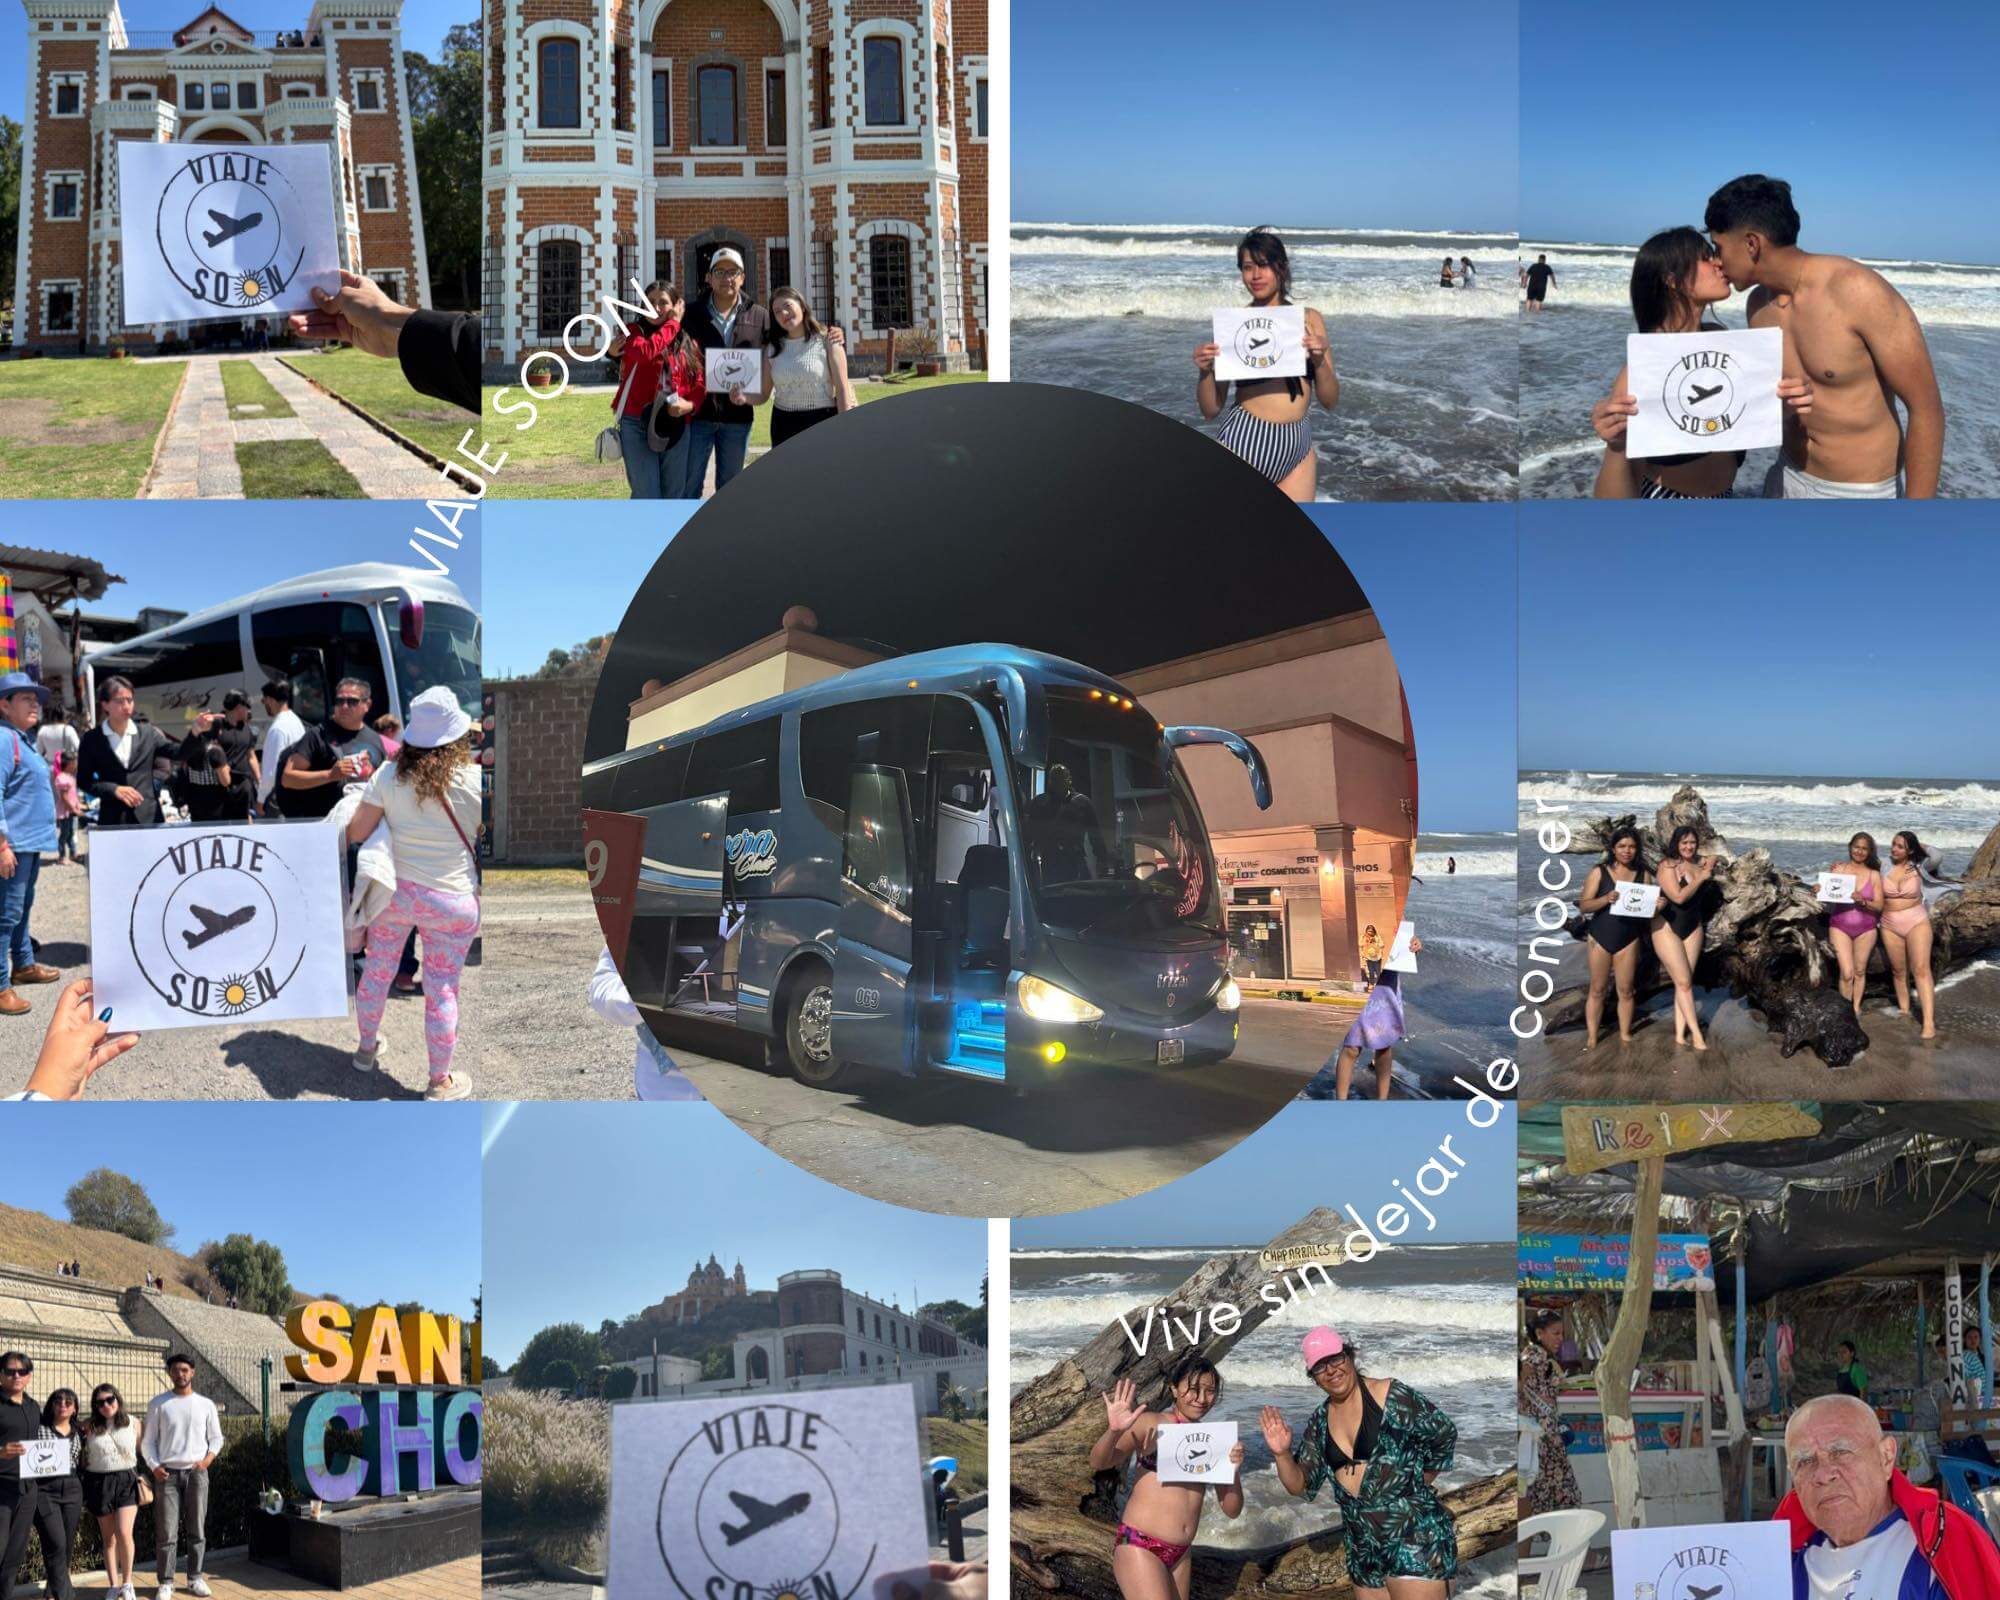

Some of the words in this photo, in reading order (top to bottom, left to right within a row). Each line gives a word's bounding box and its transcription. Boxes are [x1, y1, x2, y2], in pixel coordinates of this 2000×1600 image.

[187, 155, 270, 185] VIAJE
[1244, 319, 1273, 329] VIAJE
[1682, 351, 1730, 370] VIAJE
[168, 839, 267, 876] VIAJE
[1260, 865, 1310, 877] COSMÉTICOS
[855, 987, 881, 1009] 069
[1518, 1235, 1551, 1248] das
[1554, 1280, 1565, 1289] a
[1568, 1277, 1586, 1289] la
[285, 1301, 461, 1385] SAN
[1948, 1284, 1966, 1404] COCINA
[703, 1410, 821, 1455] VIAJE
[1185, 1432, 1212, 1443] VIAJE
[288, 1391, 482, 1502] CHO
[1674, 1547, 1729, 1568] VIAJE
